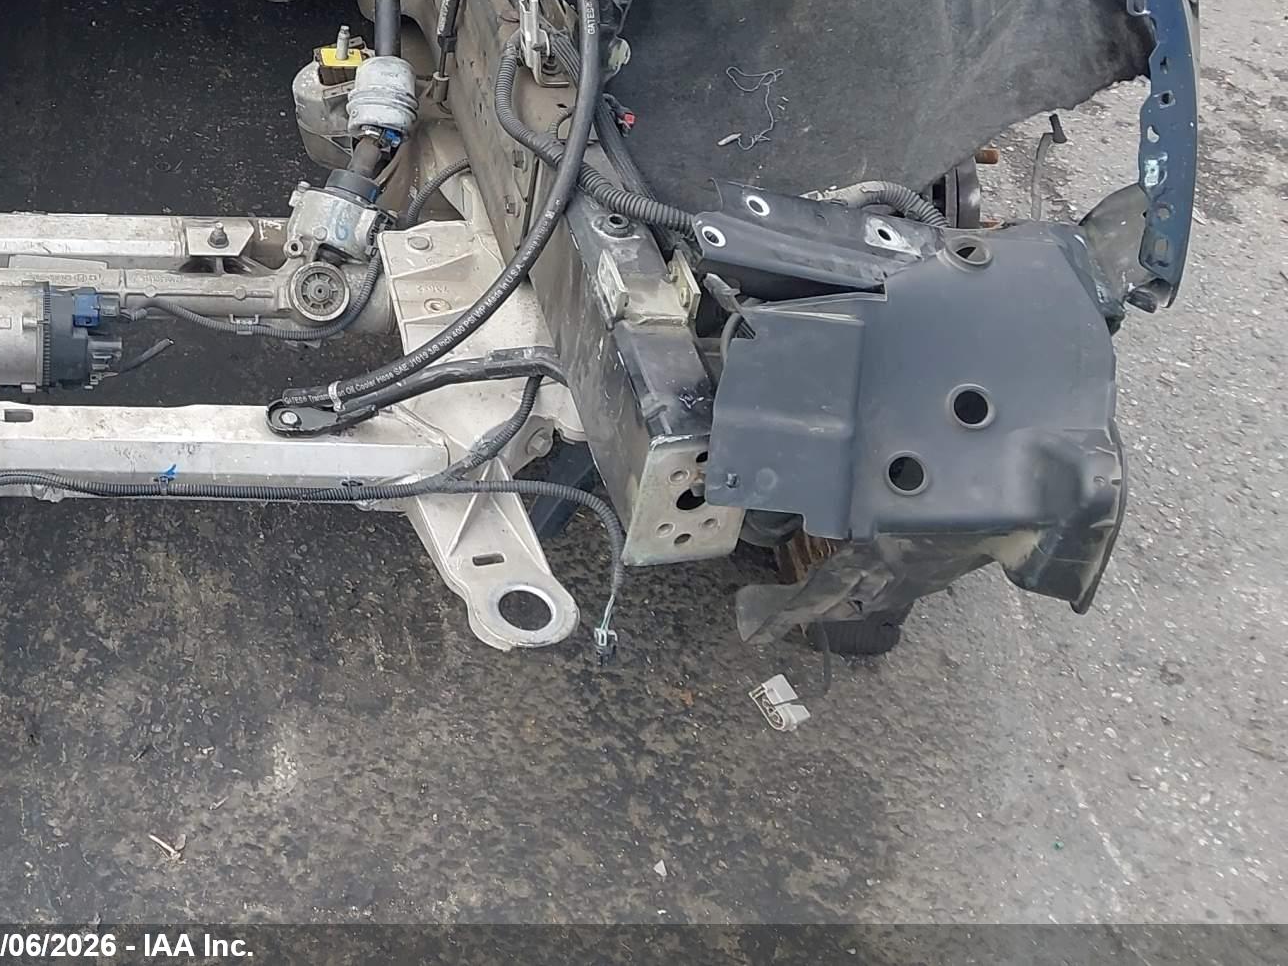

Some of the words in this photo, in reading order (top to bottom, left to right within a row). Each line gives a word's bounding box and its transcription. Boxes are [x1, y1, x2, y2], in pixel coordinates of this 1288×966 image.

[345, 384, 357, 395] Oil
[355, 379, 376, 392] Cooler
[375, 373, 395, 384] Hose
[393, 363, 410, 376] SAE
[452, 324, 466, 338] 400
[463, 315, 478, 329] PSI
[473, 305, 487, 320] WP
[485, 289, 504, 309] Made
